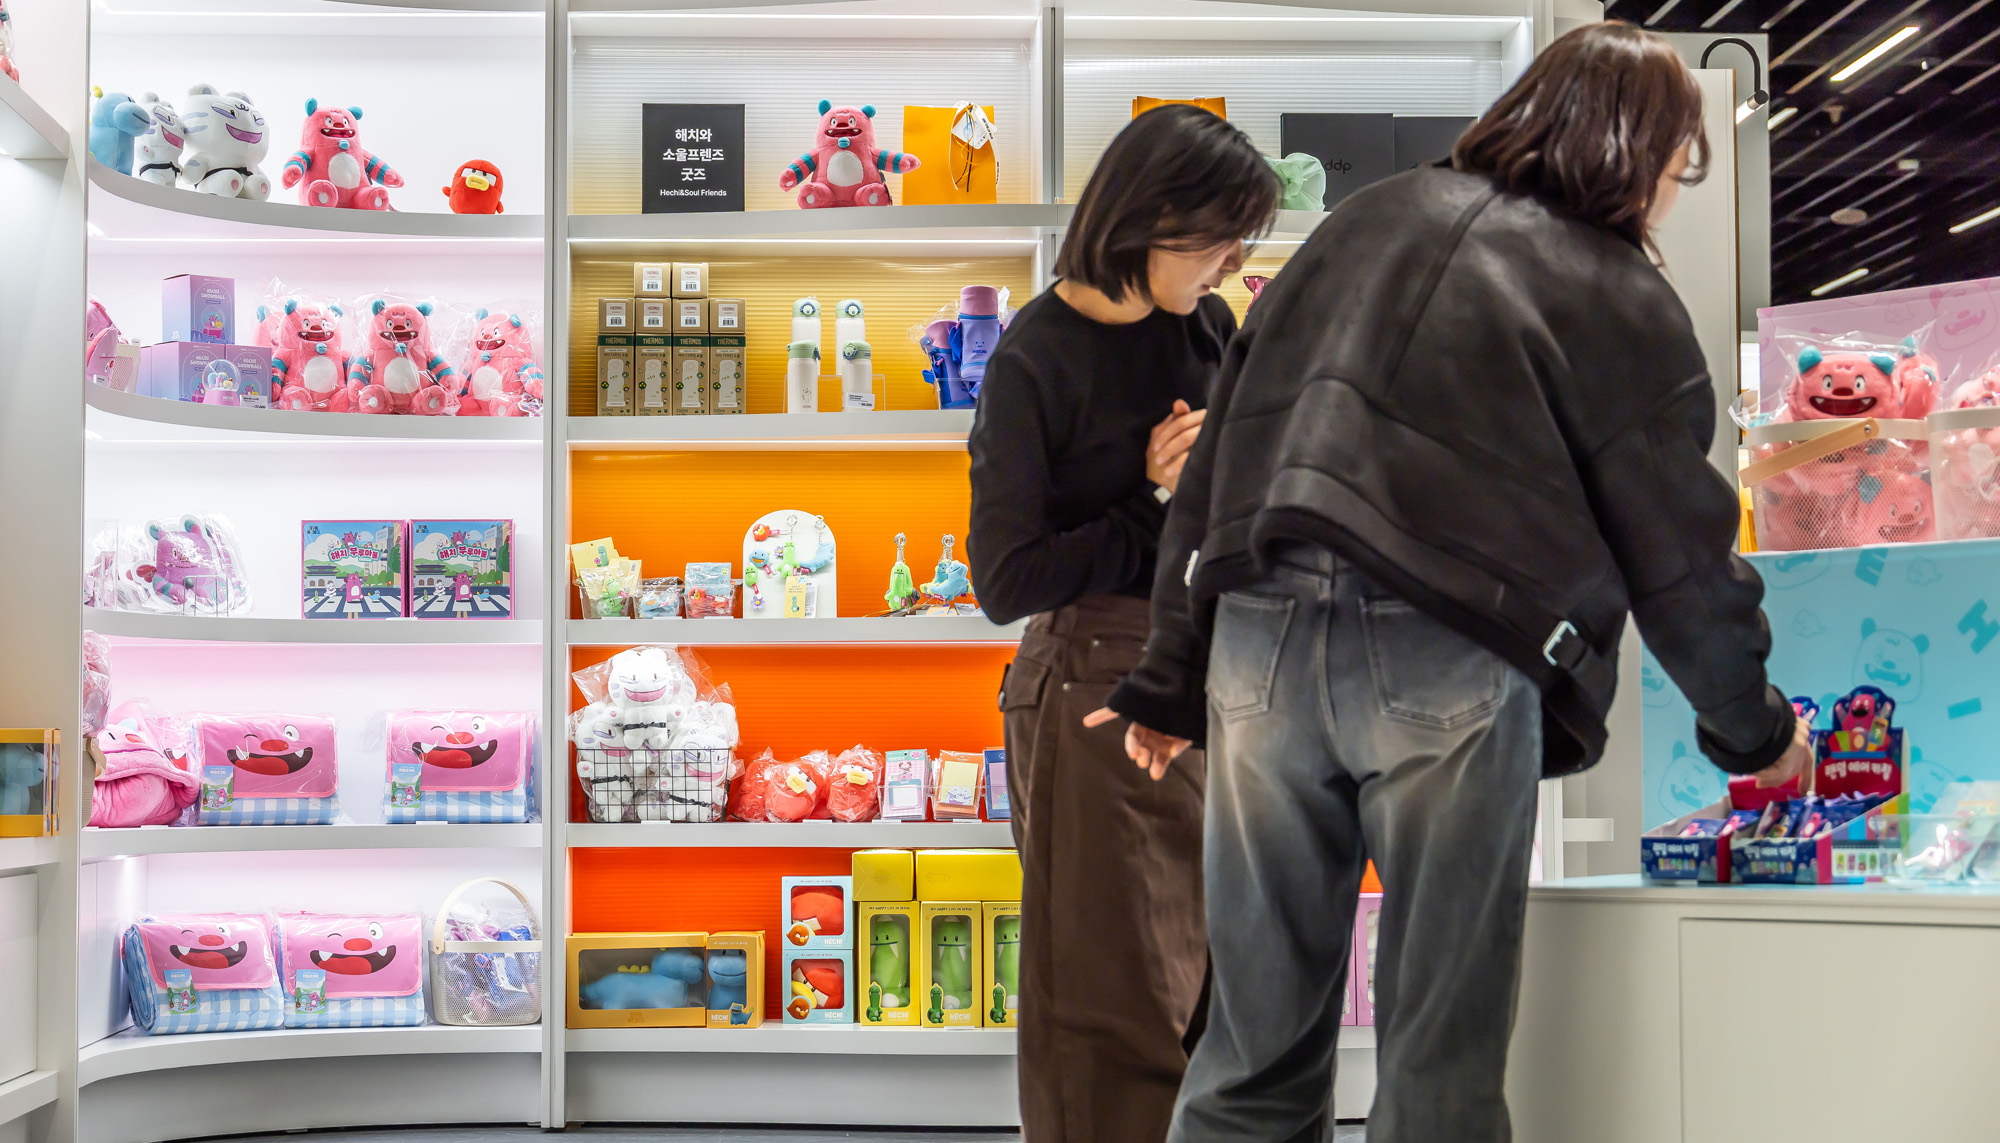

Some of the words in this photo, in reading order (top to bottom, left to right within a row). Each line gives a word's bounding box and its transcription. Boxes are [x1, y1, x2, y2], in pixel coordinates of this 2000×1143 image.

[675, 128, 712, 142] 해치와
[662, 148, 724, 162] 소울프렌즈
[1324, 159, 1352, 174] ddp
[681, 168, 706, 181] 굿즈
[660, 189, 700, 197] Hechi&Soul
[701, 189, 727, 197] Friends
[331, 549, 347, 560] 해치
[439, 548, 456, 559] 해치
